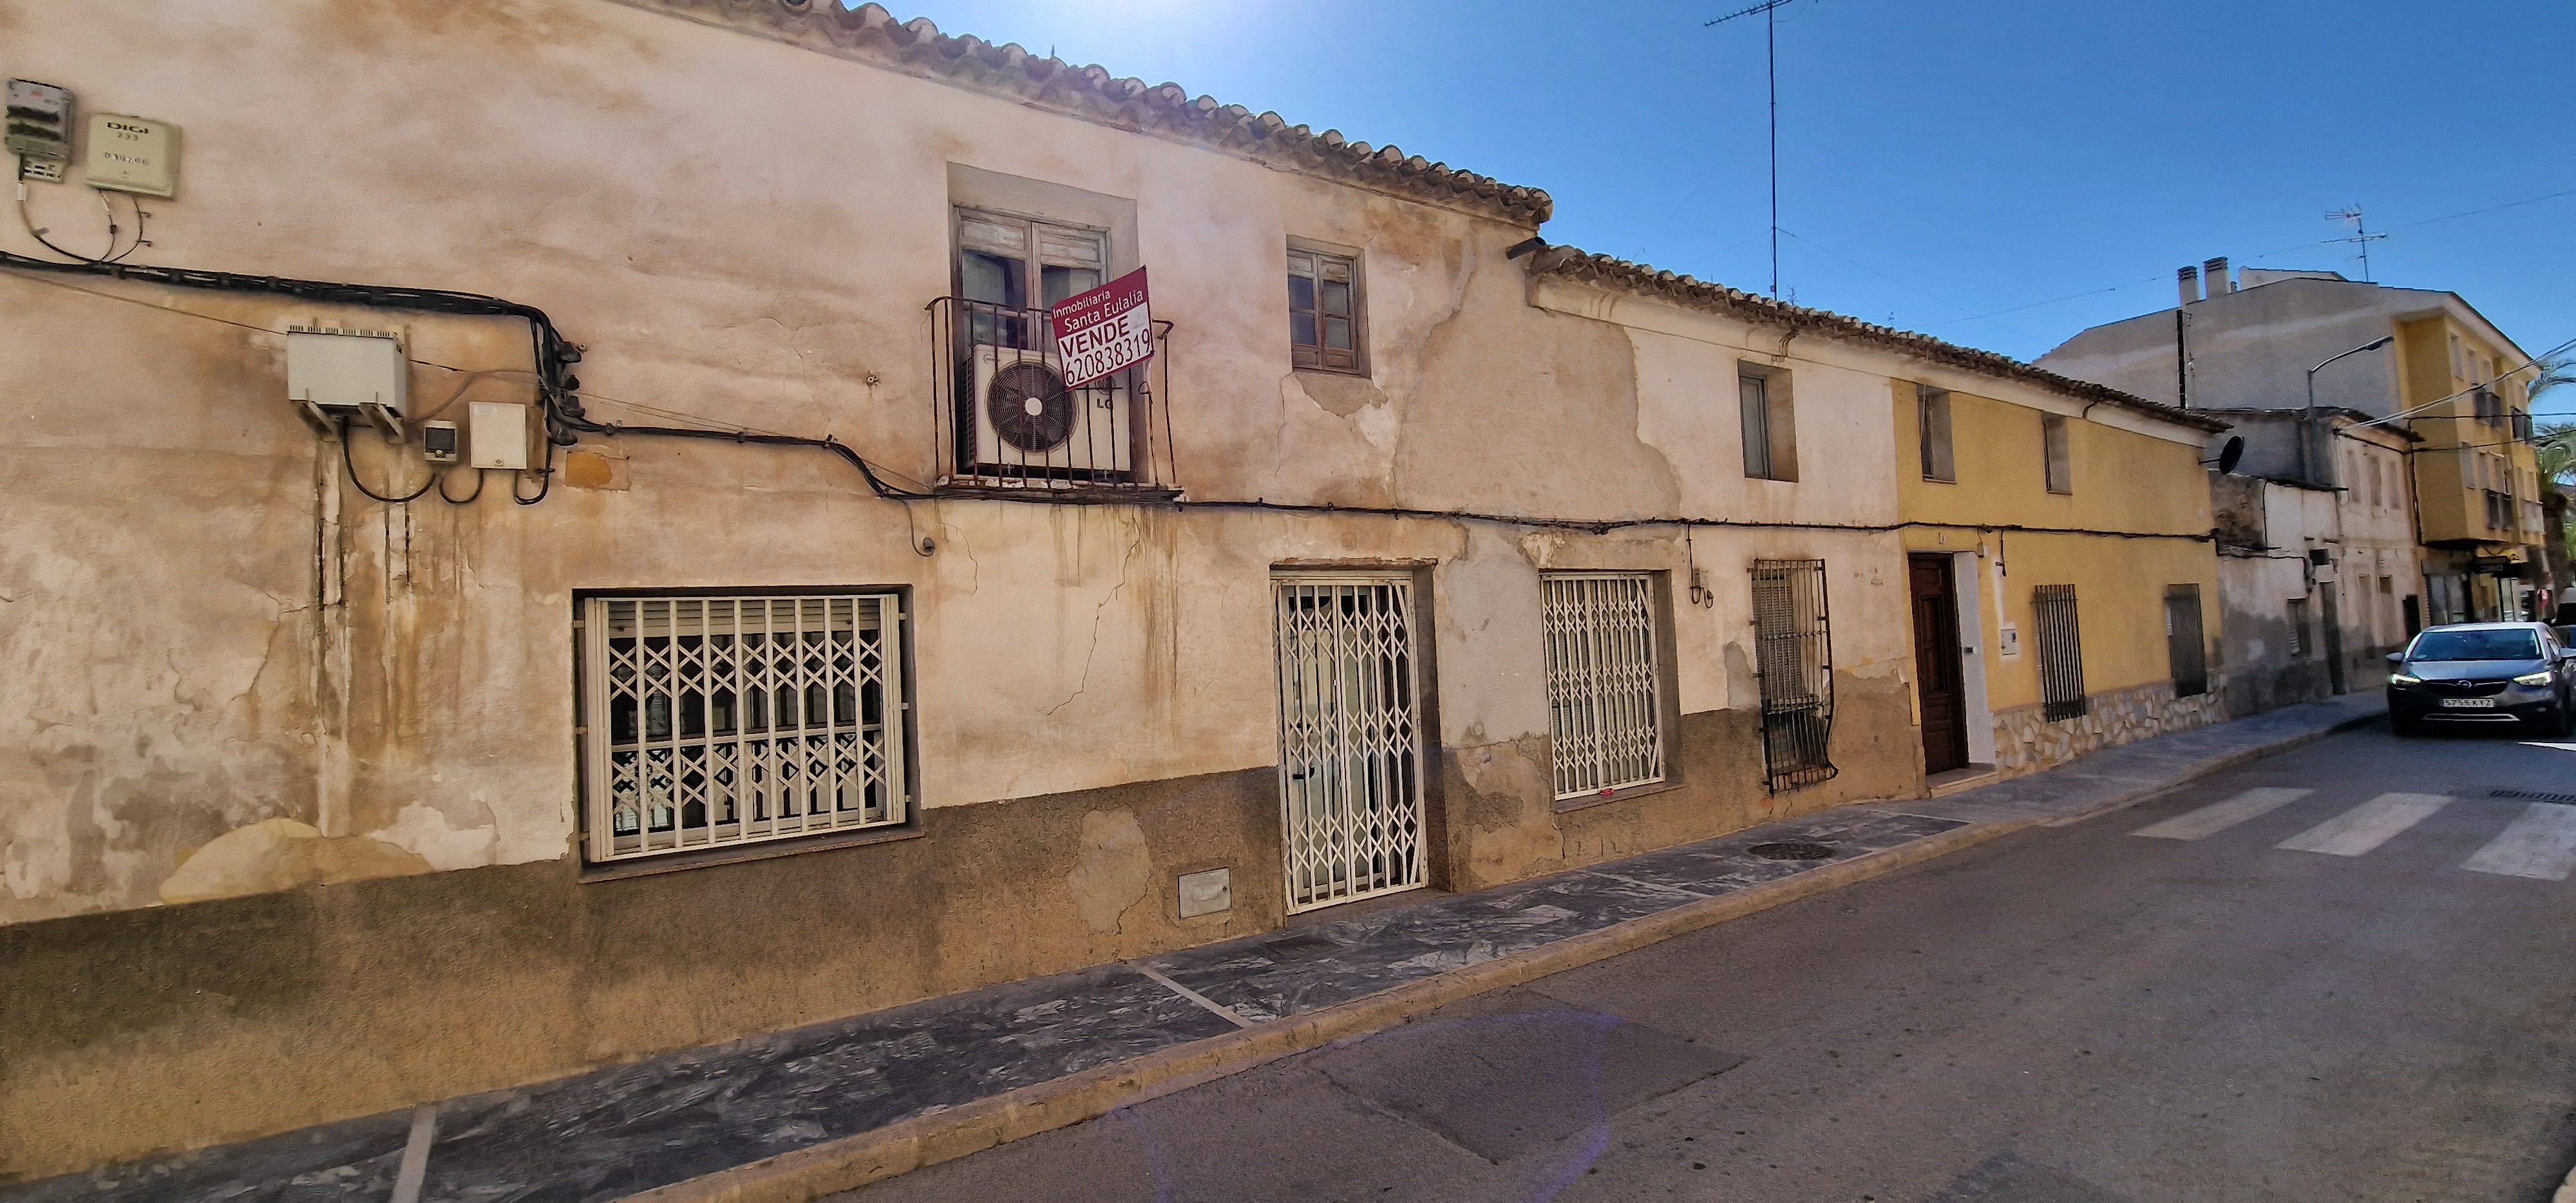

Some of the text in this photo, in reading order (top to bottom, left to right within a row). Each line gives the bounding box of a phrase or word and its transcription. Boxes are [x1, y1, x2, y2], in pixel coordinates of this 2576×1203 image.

[107, 122, 149, 134] DIGI
[1053, 290, 1111, 319] Inmobiliaria
[1065, 290, 1144, 332] Santa Eulalia
[1061, 315, 1130, 358] VENDE
[1065, 328, 1150, 385] 620838319
[1097, 398, 1113, 410] LG
